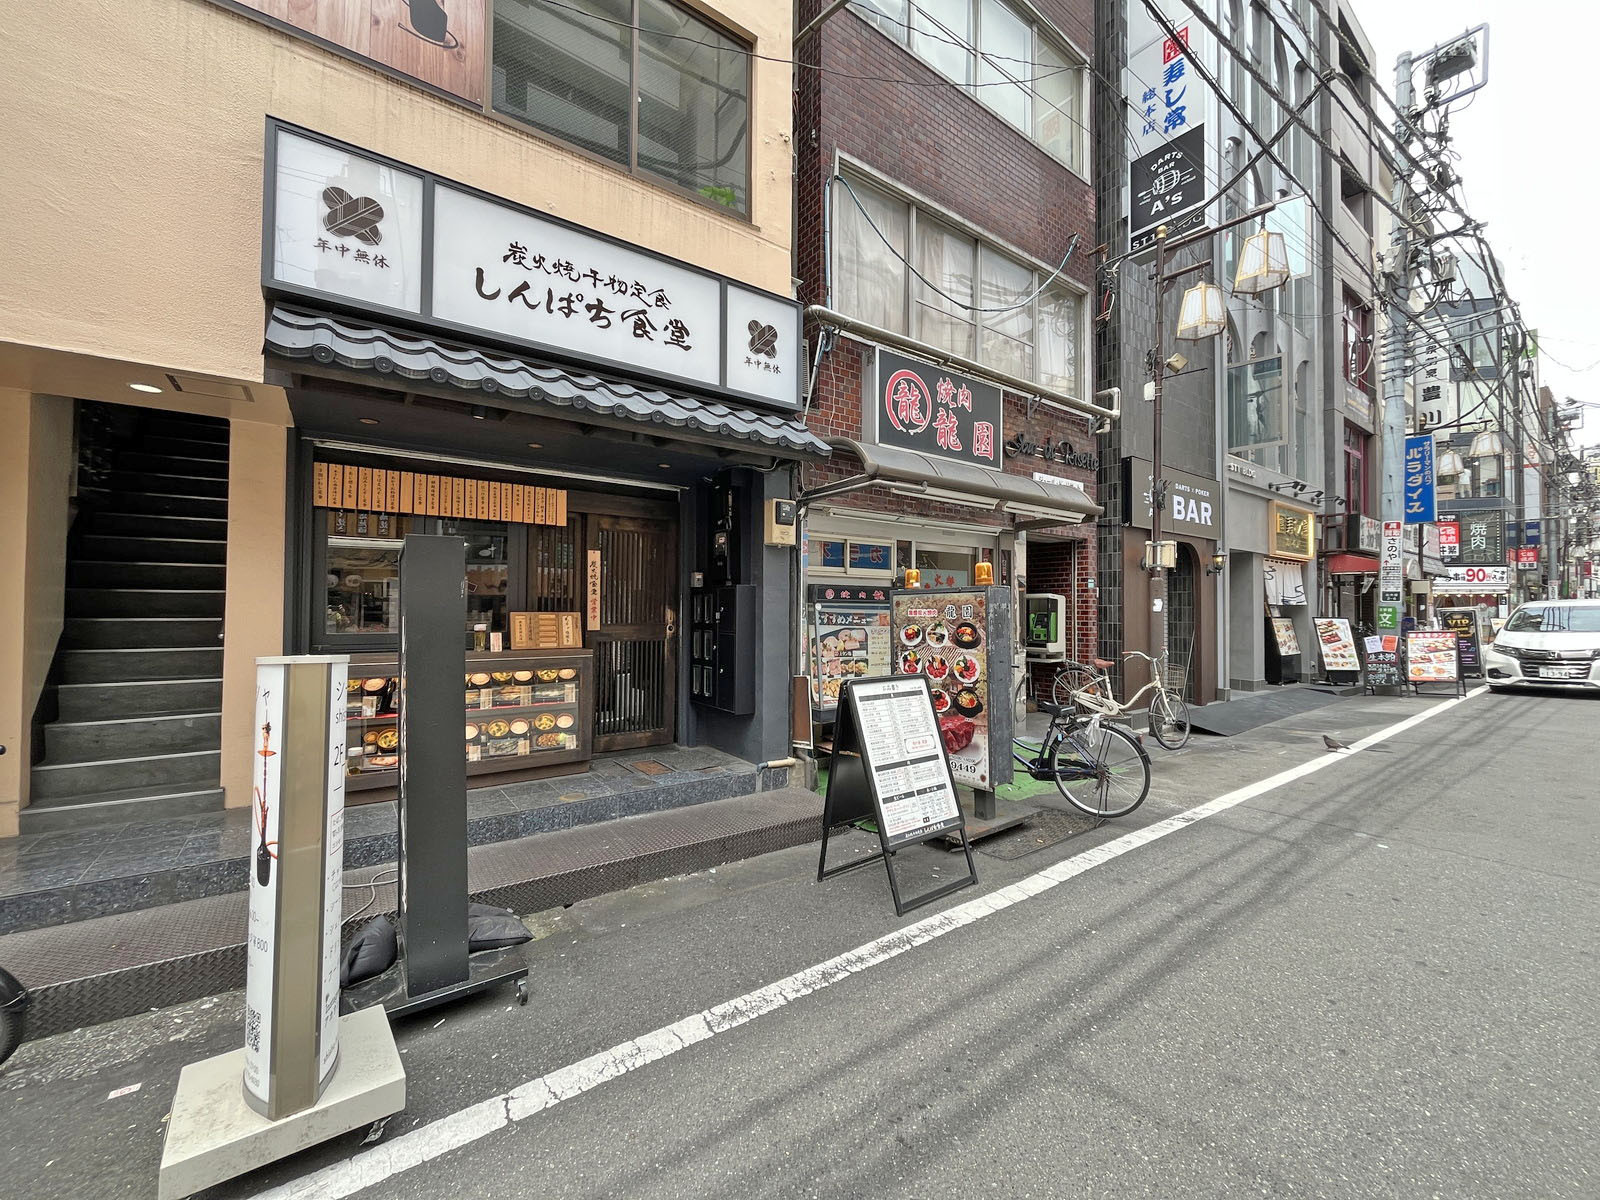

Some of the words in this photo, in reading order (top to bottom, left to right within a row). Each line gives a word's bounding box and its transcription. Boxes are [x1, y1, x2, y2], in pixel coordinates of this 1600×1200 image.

[1163, 57, 1187, 135] 寿し常
[1150, 151, 1183, 172] DARTS
[1157, 161, 1175, 175] BAR
[313, 236, 391, 270] 年中無休
[502, 241, 673, 310] 炭火焼干物定食
[474, 267, 693, 352] しんぱち食堂
[744, 355, 782, 375] 年中無休
[936, 377, 973, 413] 焼肉
[1175, 482, 1190, 493] DARTS
[1195, 488, 1210, 498] POKER
[1406, 447, 1425, 514] パラダイス
[1172, 494, 1213, 526] BAR
[1387, 537, 1398, 561] さのや
[1470, 521, 1488, 550] 焼肉
